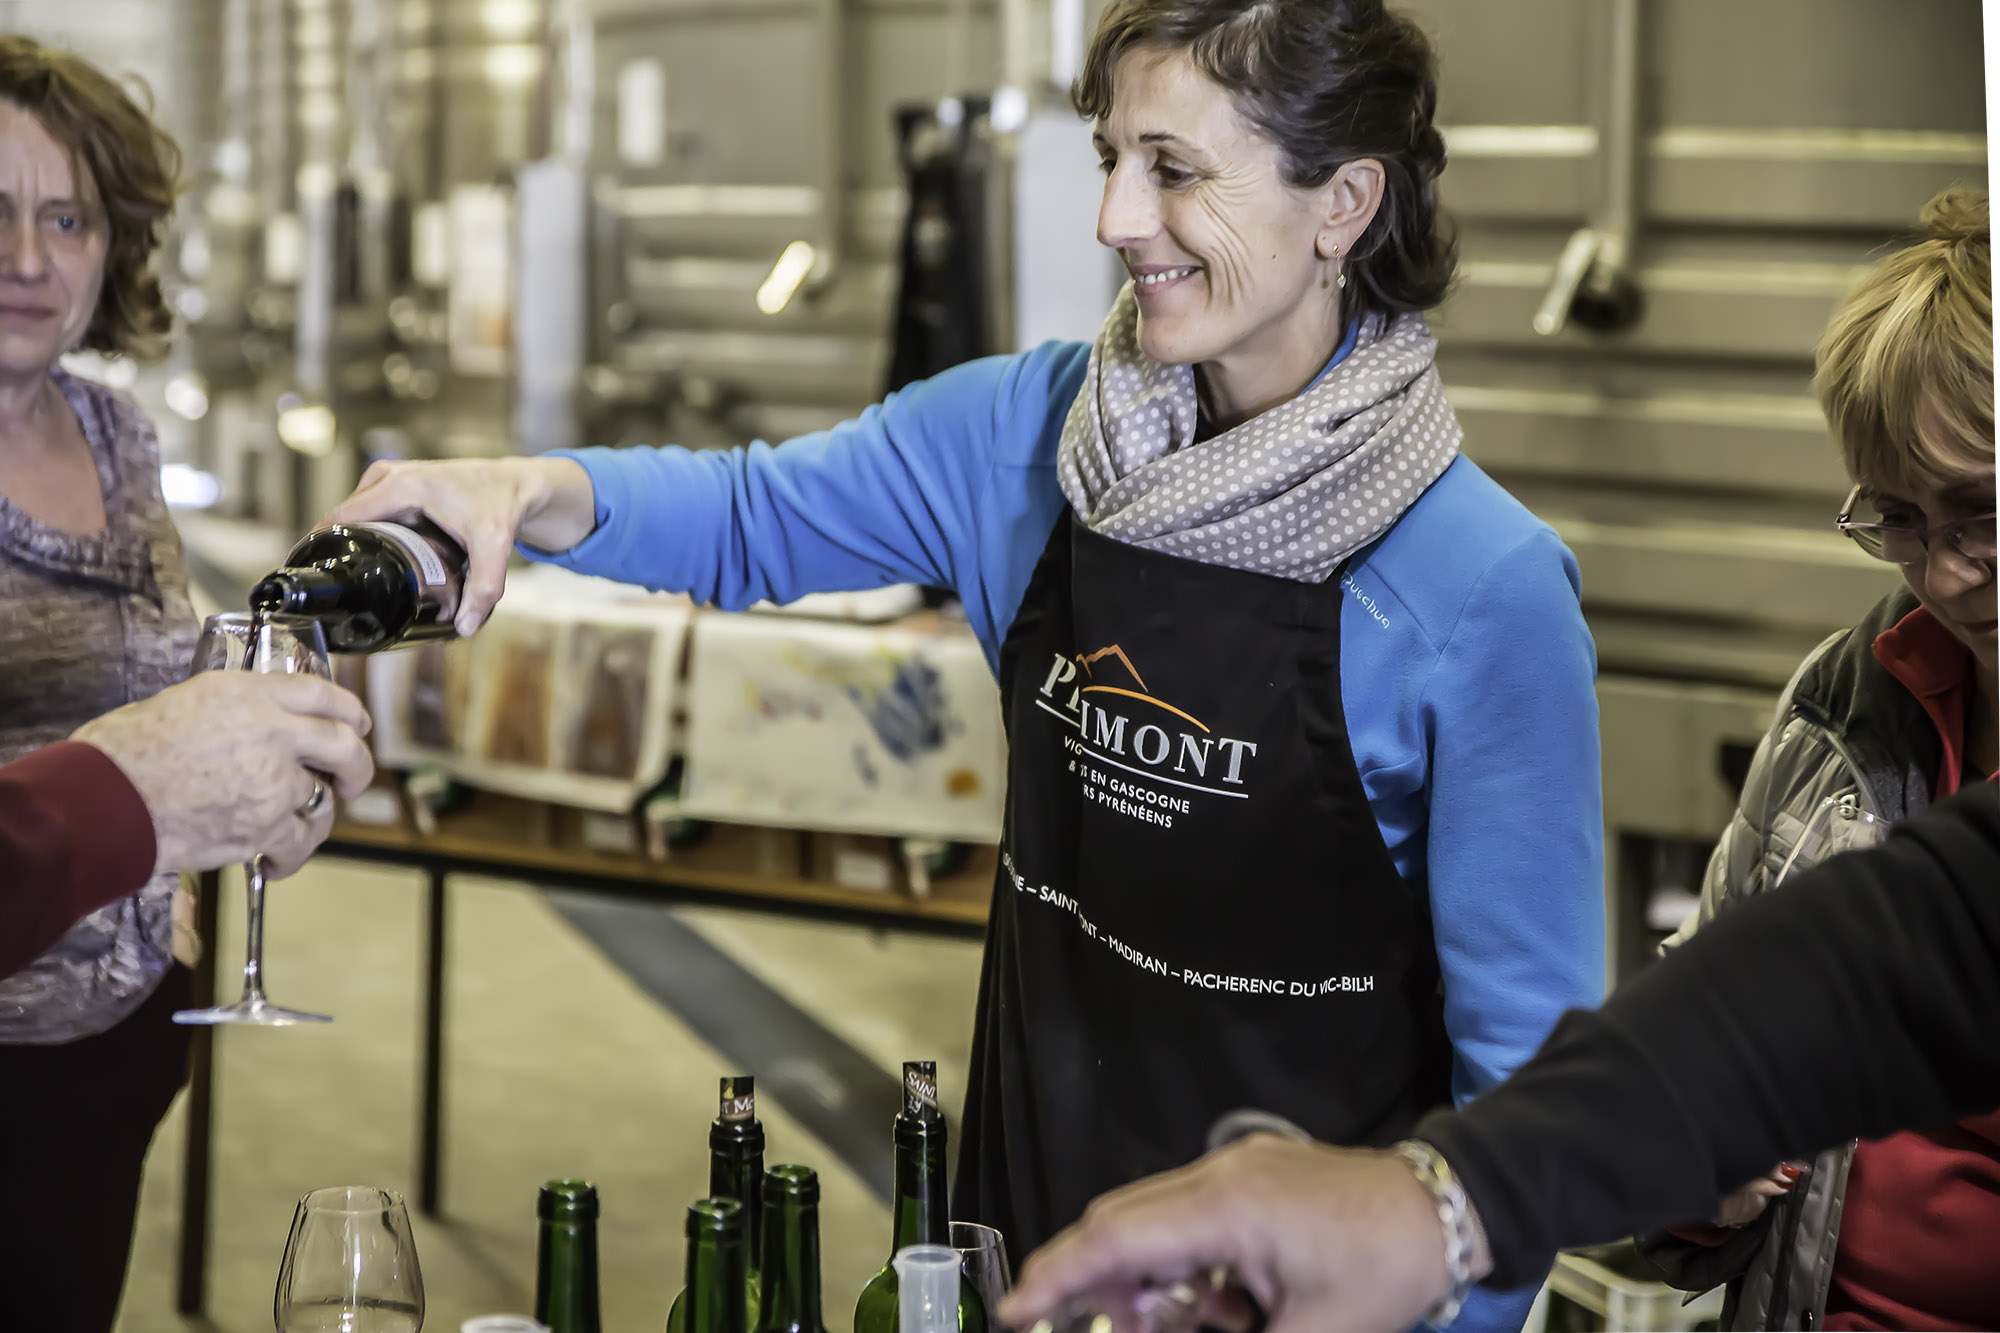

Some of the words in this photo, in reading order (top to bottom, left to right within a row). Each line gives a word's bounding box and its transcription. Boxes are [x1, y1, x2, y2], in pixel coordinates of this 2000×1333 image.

[1064, 735, 1082, 756] VIG
[1083, 783, 1095, 800] RS
[1098, 791, 1172, 828] PYRÉNÉENS
[1091, 769, 1106, 786] EN
[1110, 778, 1190, 814] GASCOGNE
[1040, 885, 1079, 914] SAINT
[1079, 910, 1097, 939] ONT
[1109, 934, 1168, 977] MADIRAN
[1184, 968, 1286, 994] PACHERENC
[1290, 981, 1316, 997] DU
[1319, 975, 1374, 996] VIC-BILH
